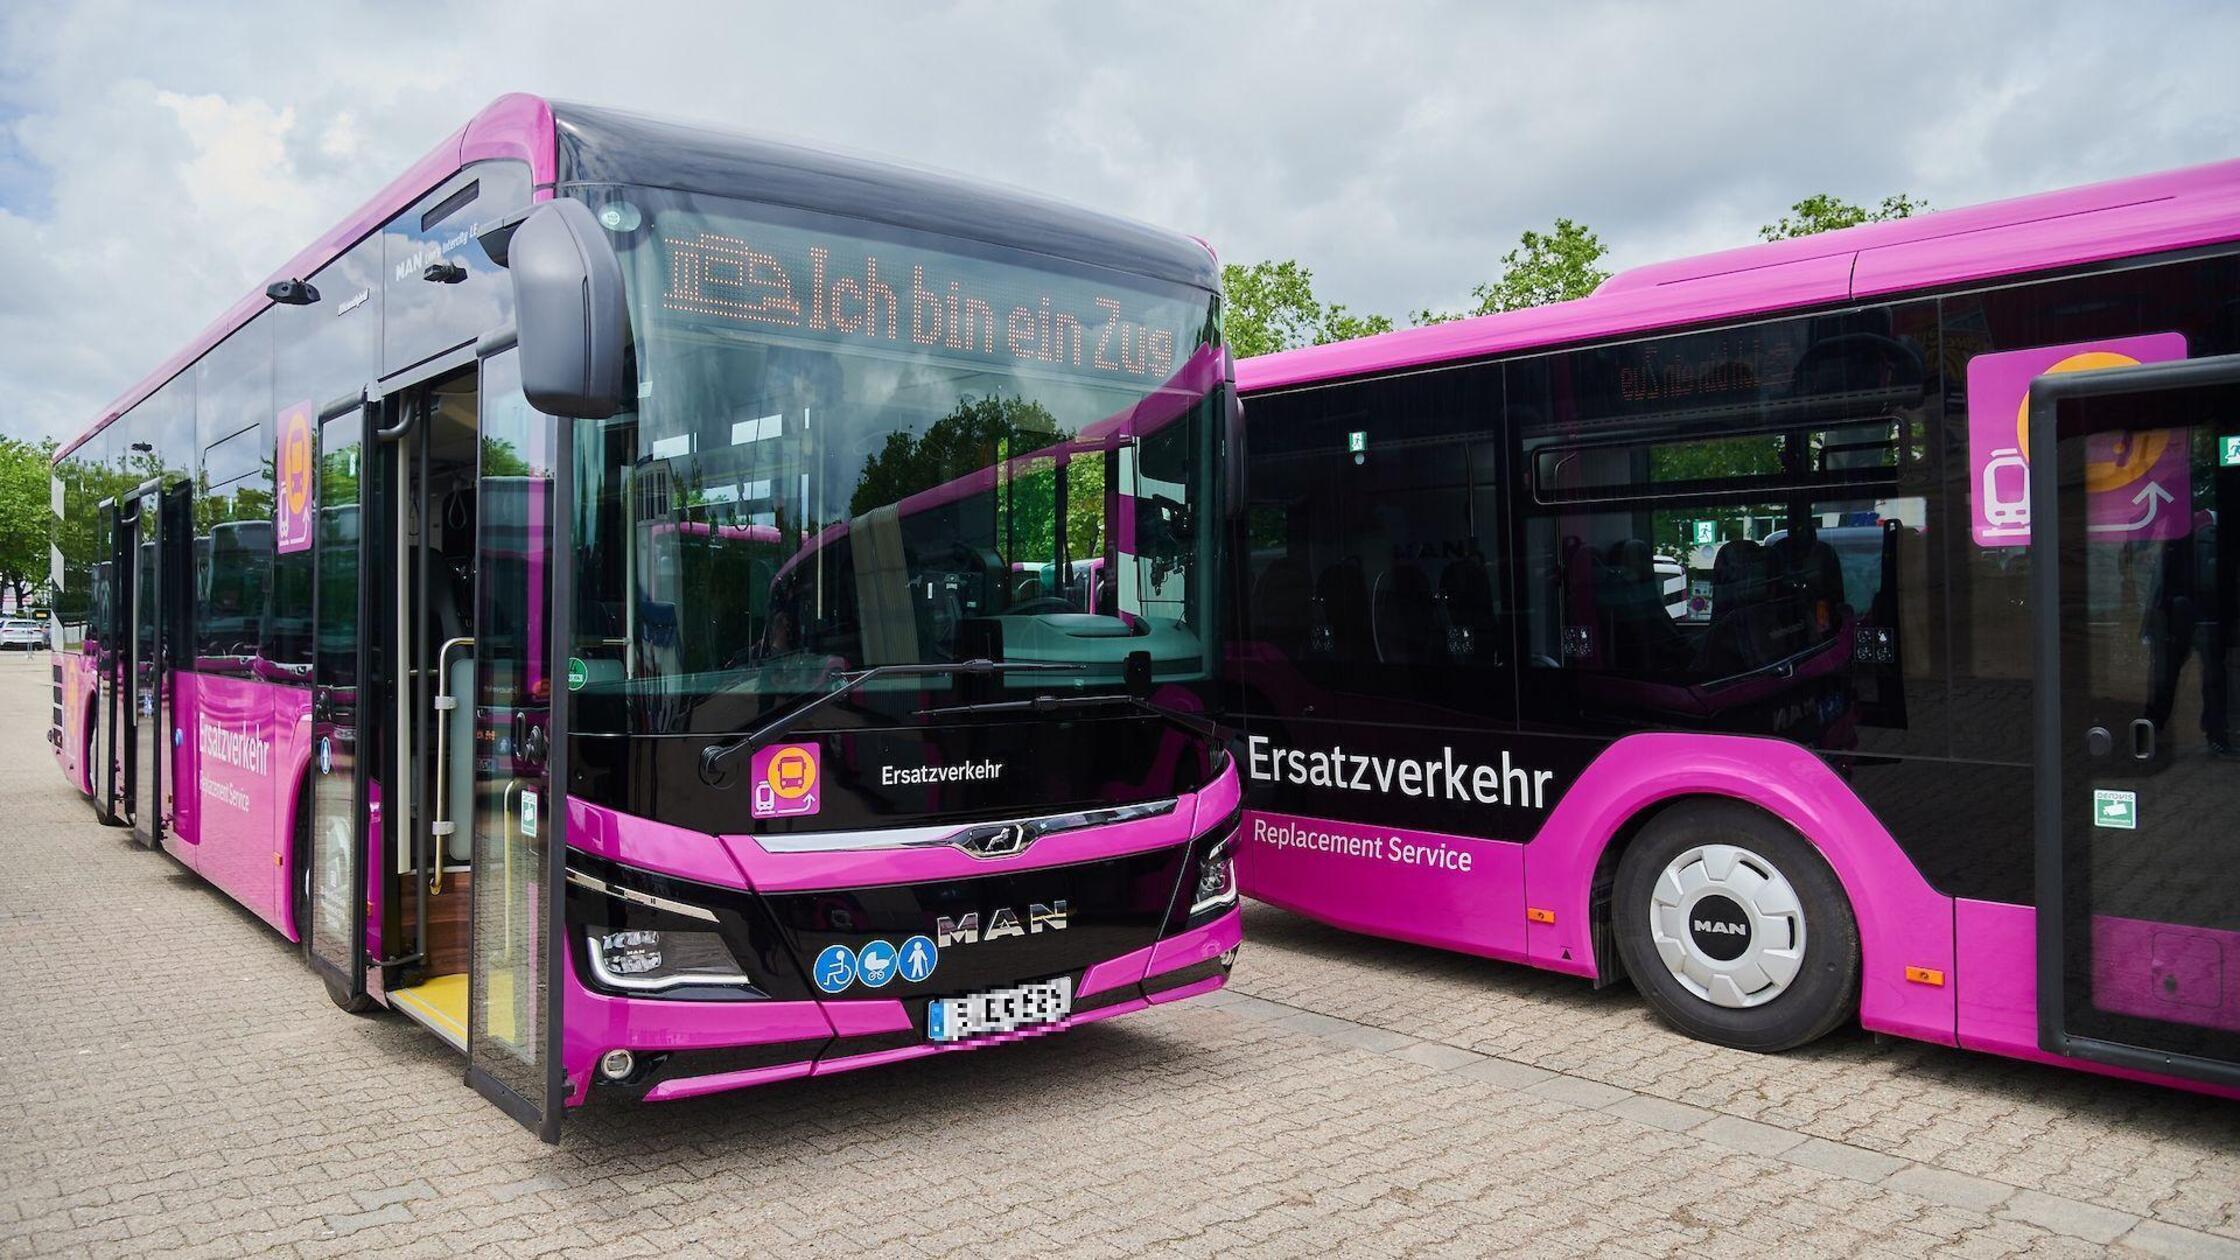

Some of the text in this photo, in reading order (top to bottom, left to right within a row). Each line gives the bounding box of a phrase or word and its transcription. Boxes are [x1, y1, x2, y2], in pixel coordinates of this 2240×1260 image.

[395, 251, 423, 282] MAN
[809, 246, 1173, 378] Ich bin ein Zug
[881, 758, 1003, 786] Ersatzverkehr
[1249, 735, 1553, 809] Ersatzverkehr
[1254, 818, 1472, 872] Replacement Service
[936, 899, 1068, 948] MAN
[1694, 919, 1746, 936] MAN
